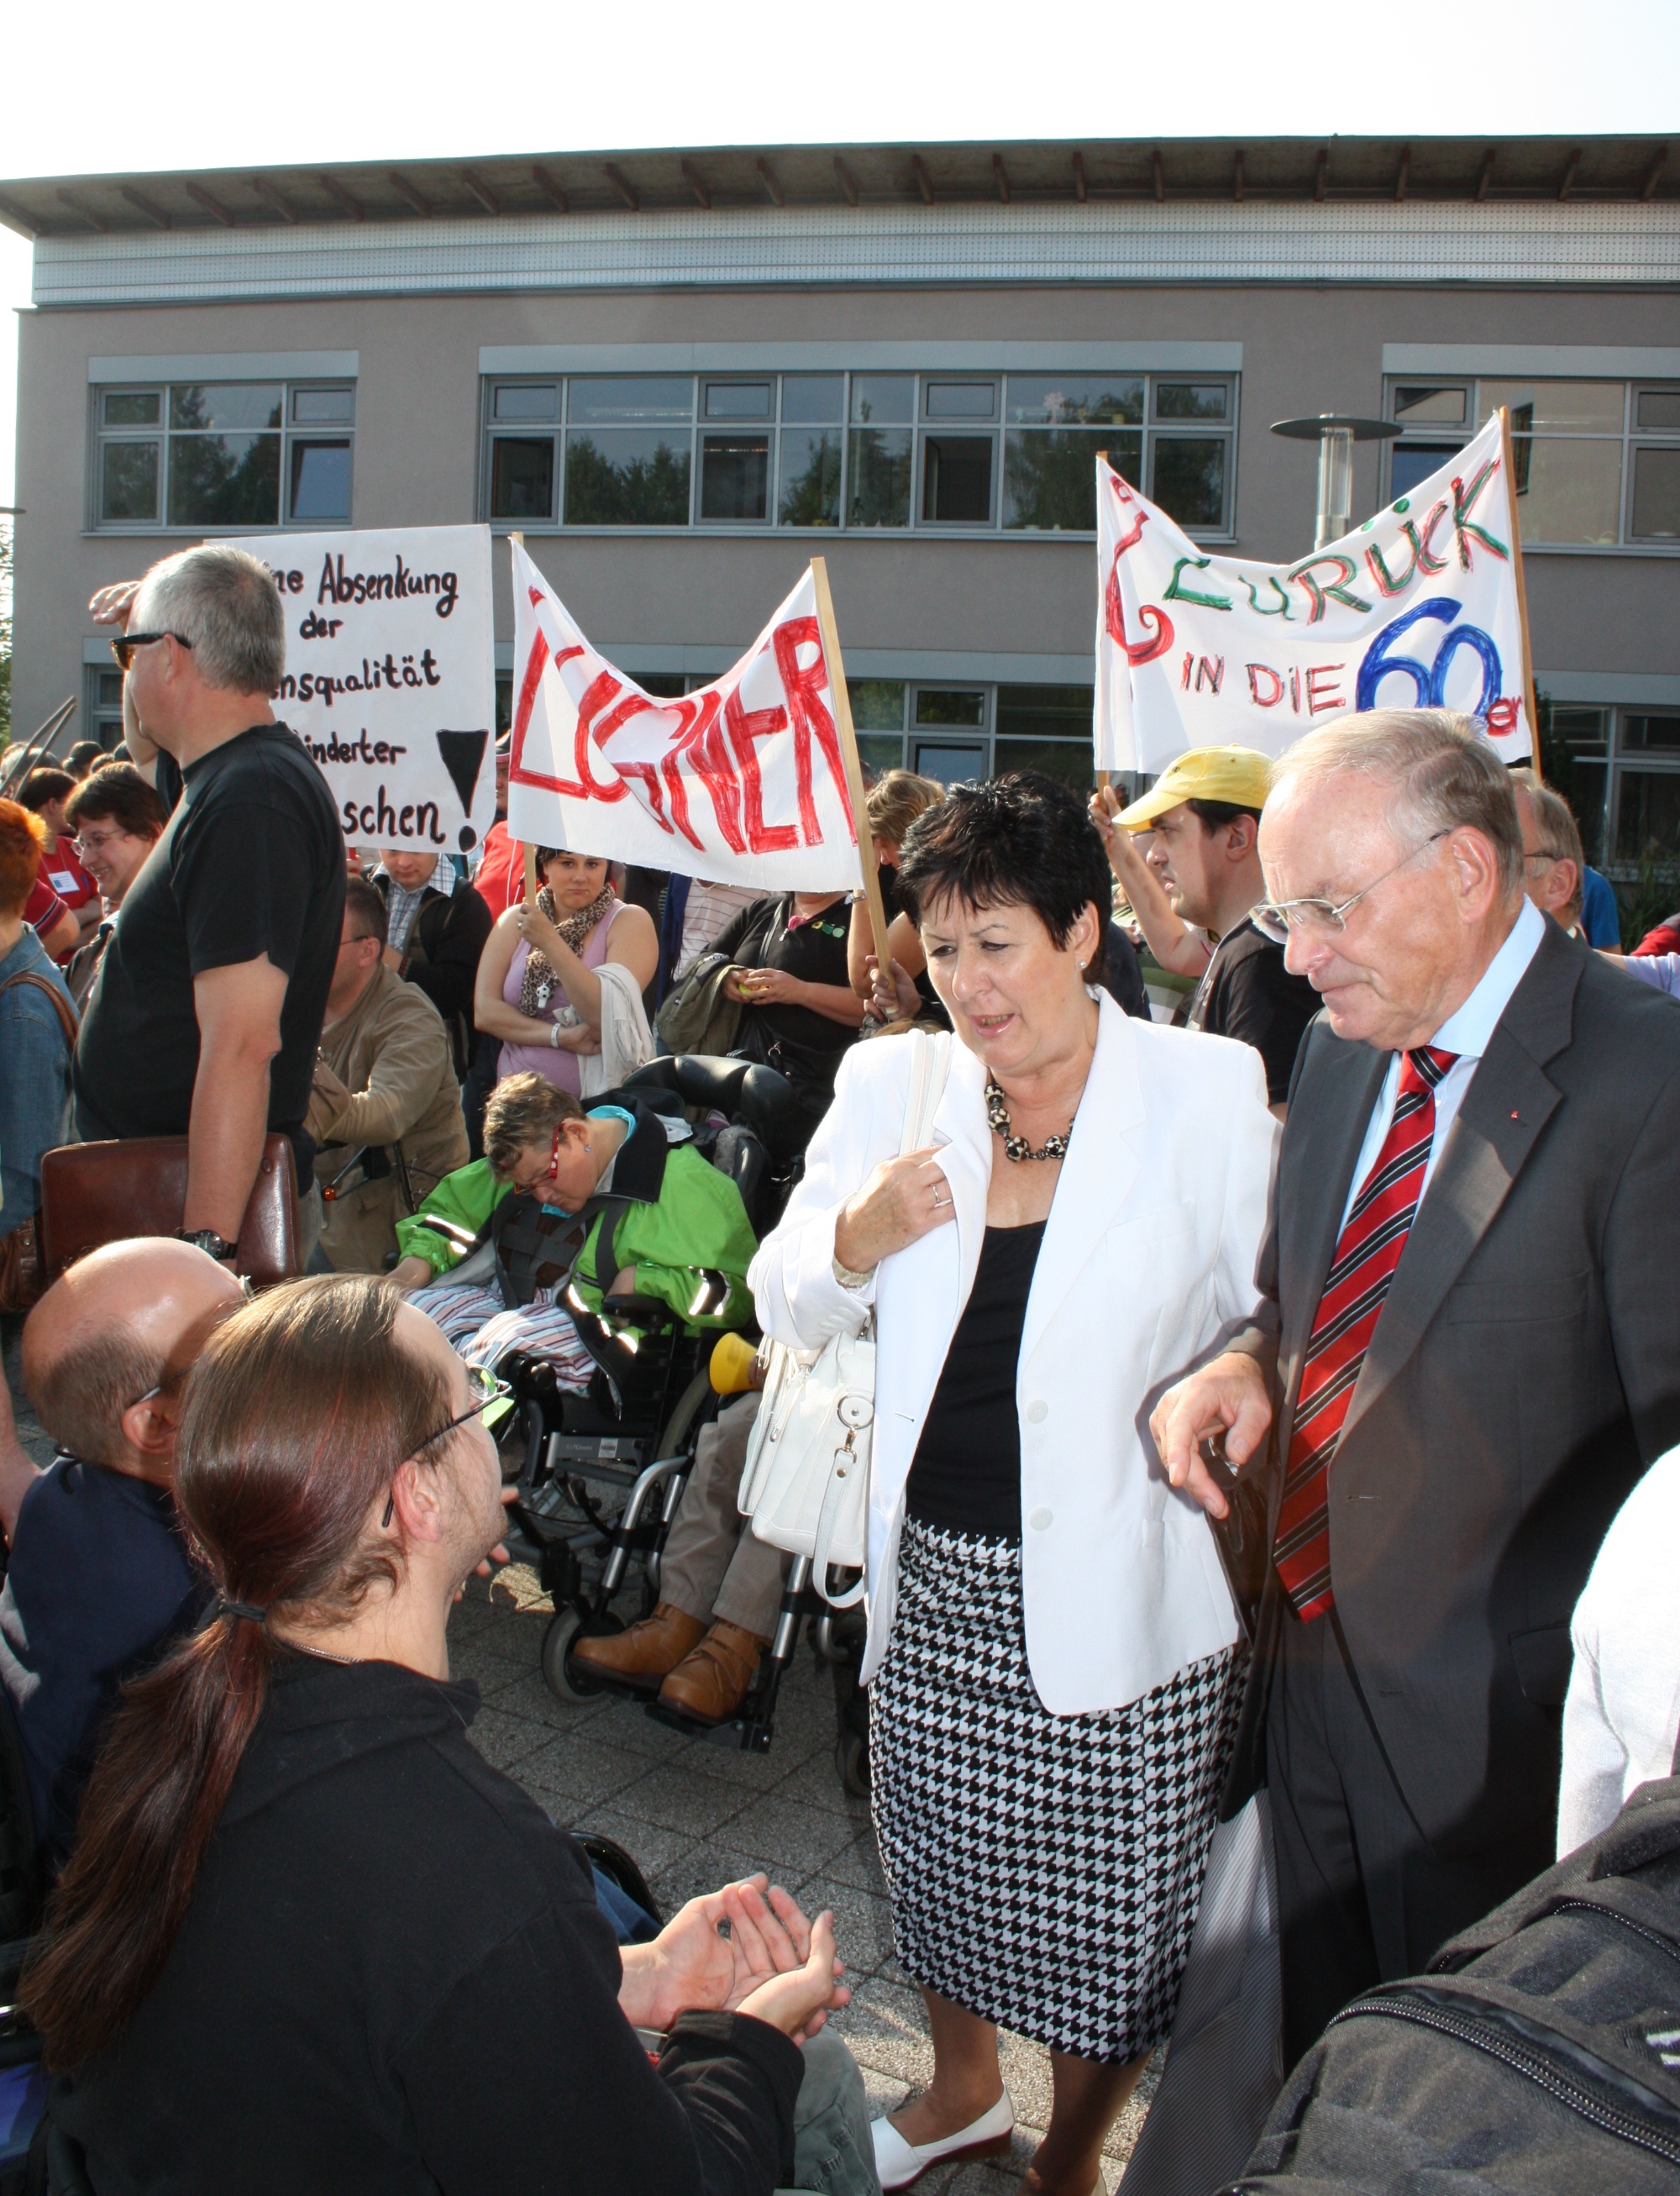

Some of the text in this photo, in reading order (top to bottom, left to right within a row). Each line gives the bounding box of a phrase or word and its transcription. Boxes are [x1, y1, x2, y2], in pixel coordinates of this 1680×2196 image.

[269, 552, 459, 617] ne Absenkung
[299, 611, 344, 639] der
[270, 649, 441, 707] nsqualität
[1179, 650, 1226, 696] IN
[1245, 662, 1347, 717] DIE
[296, 728, 407, 765] inderter
